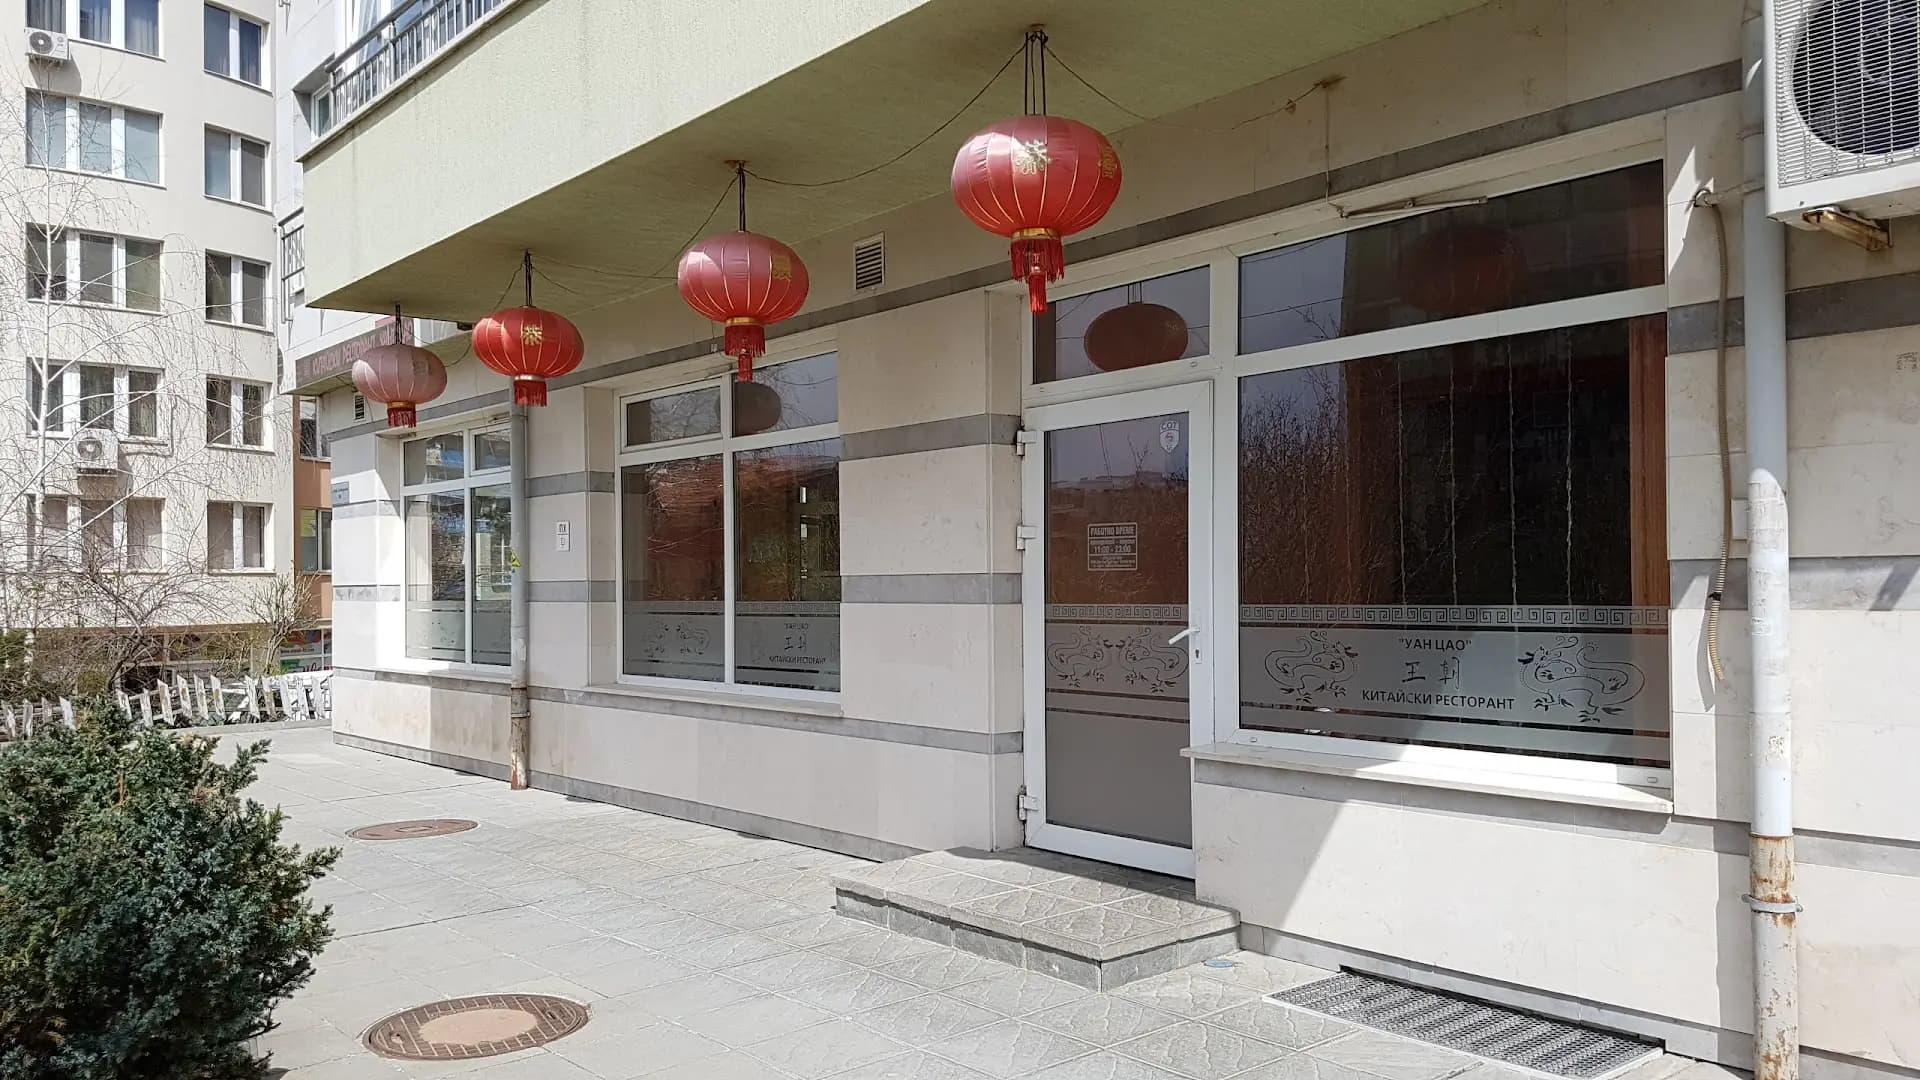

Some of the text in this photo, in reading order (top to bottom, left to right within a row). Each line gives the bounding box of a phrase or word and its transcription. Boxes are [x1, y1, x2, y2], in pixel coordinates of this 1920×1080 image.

[1398, 638, 1472, 652] "УАН ЦАО"
[1362, 689, 1515, 710] КИТАЙСКИ РЕСТОРАНТ
